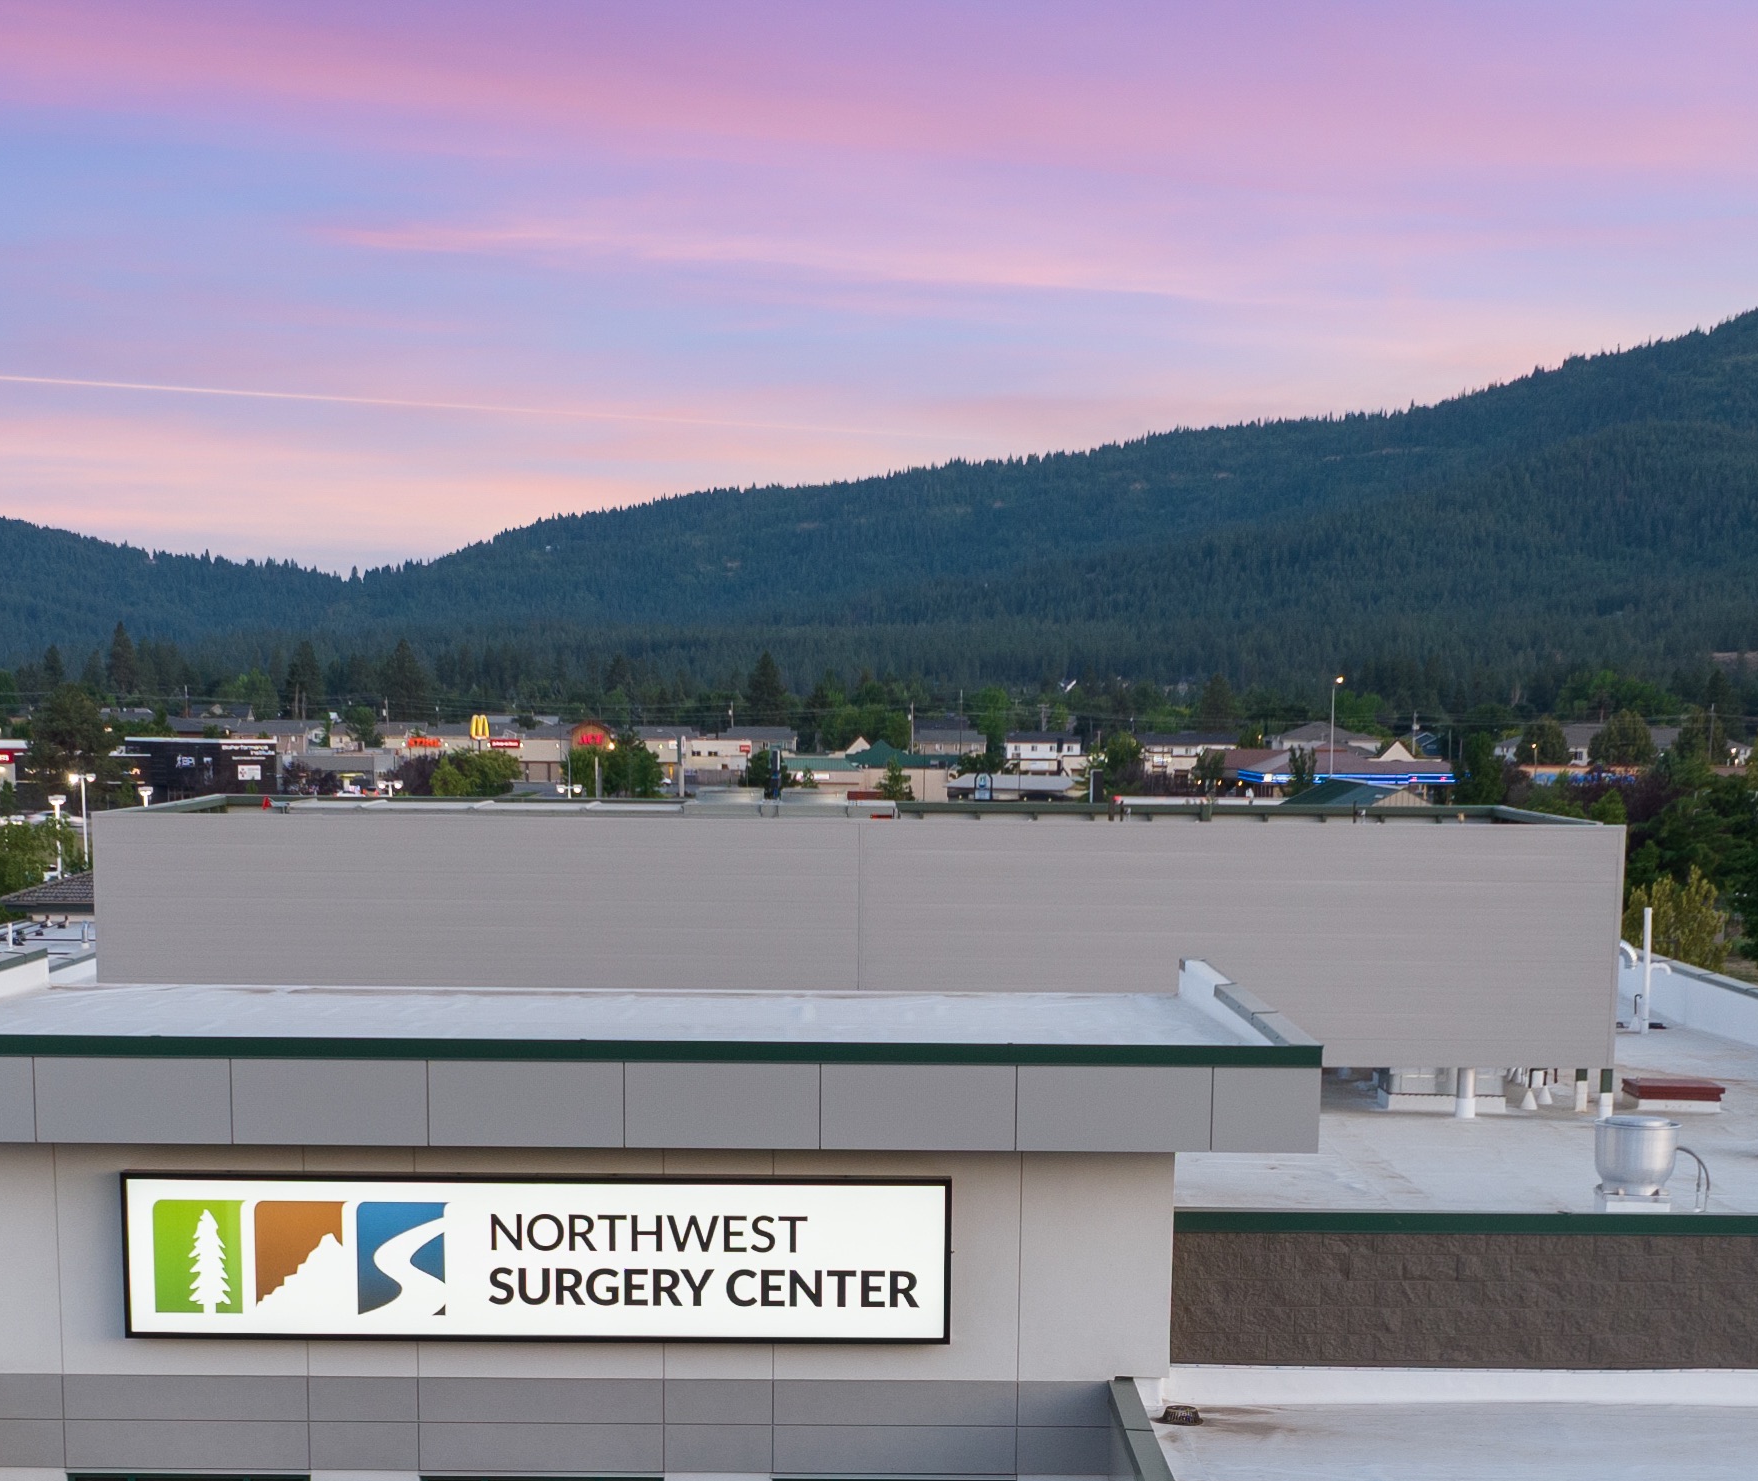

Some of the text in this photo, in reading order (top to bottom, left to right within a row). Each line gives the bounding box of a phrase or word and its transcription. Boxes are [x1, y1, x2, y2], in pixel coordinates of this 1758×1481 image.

[489, 1213, 809, 1253] NORTHWEST
[488, 1266, 921, 1309] SURGERY CENTER
